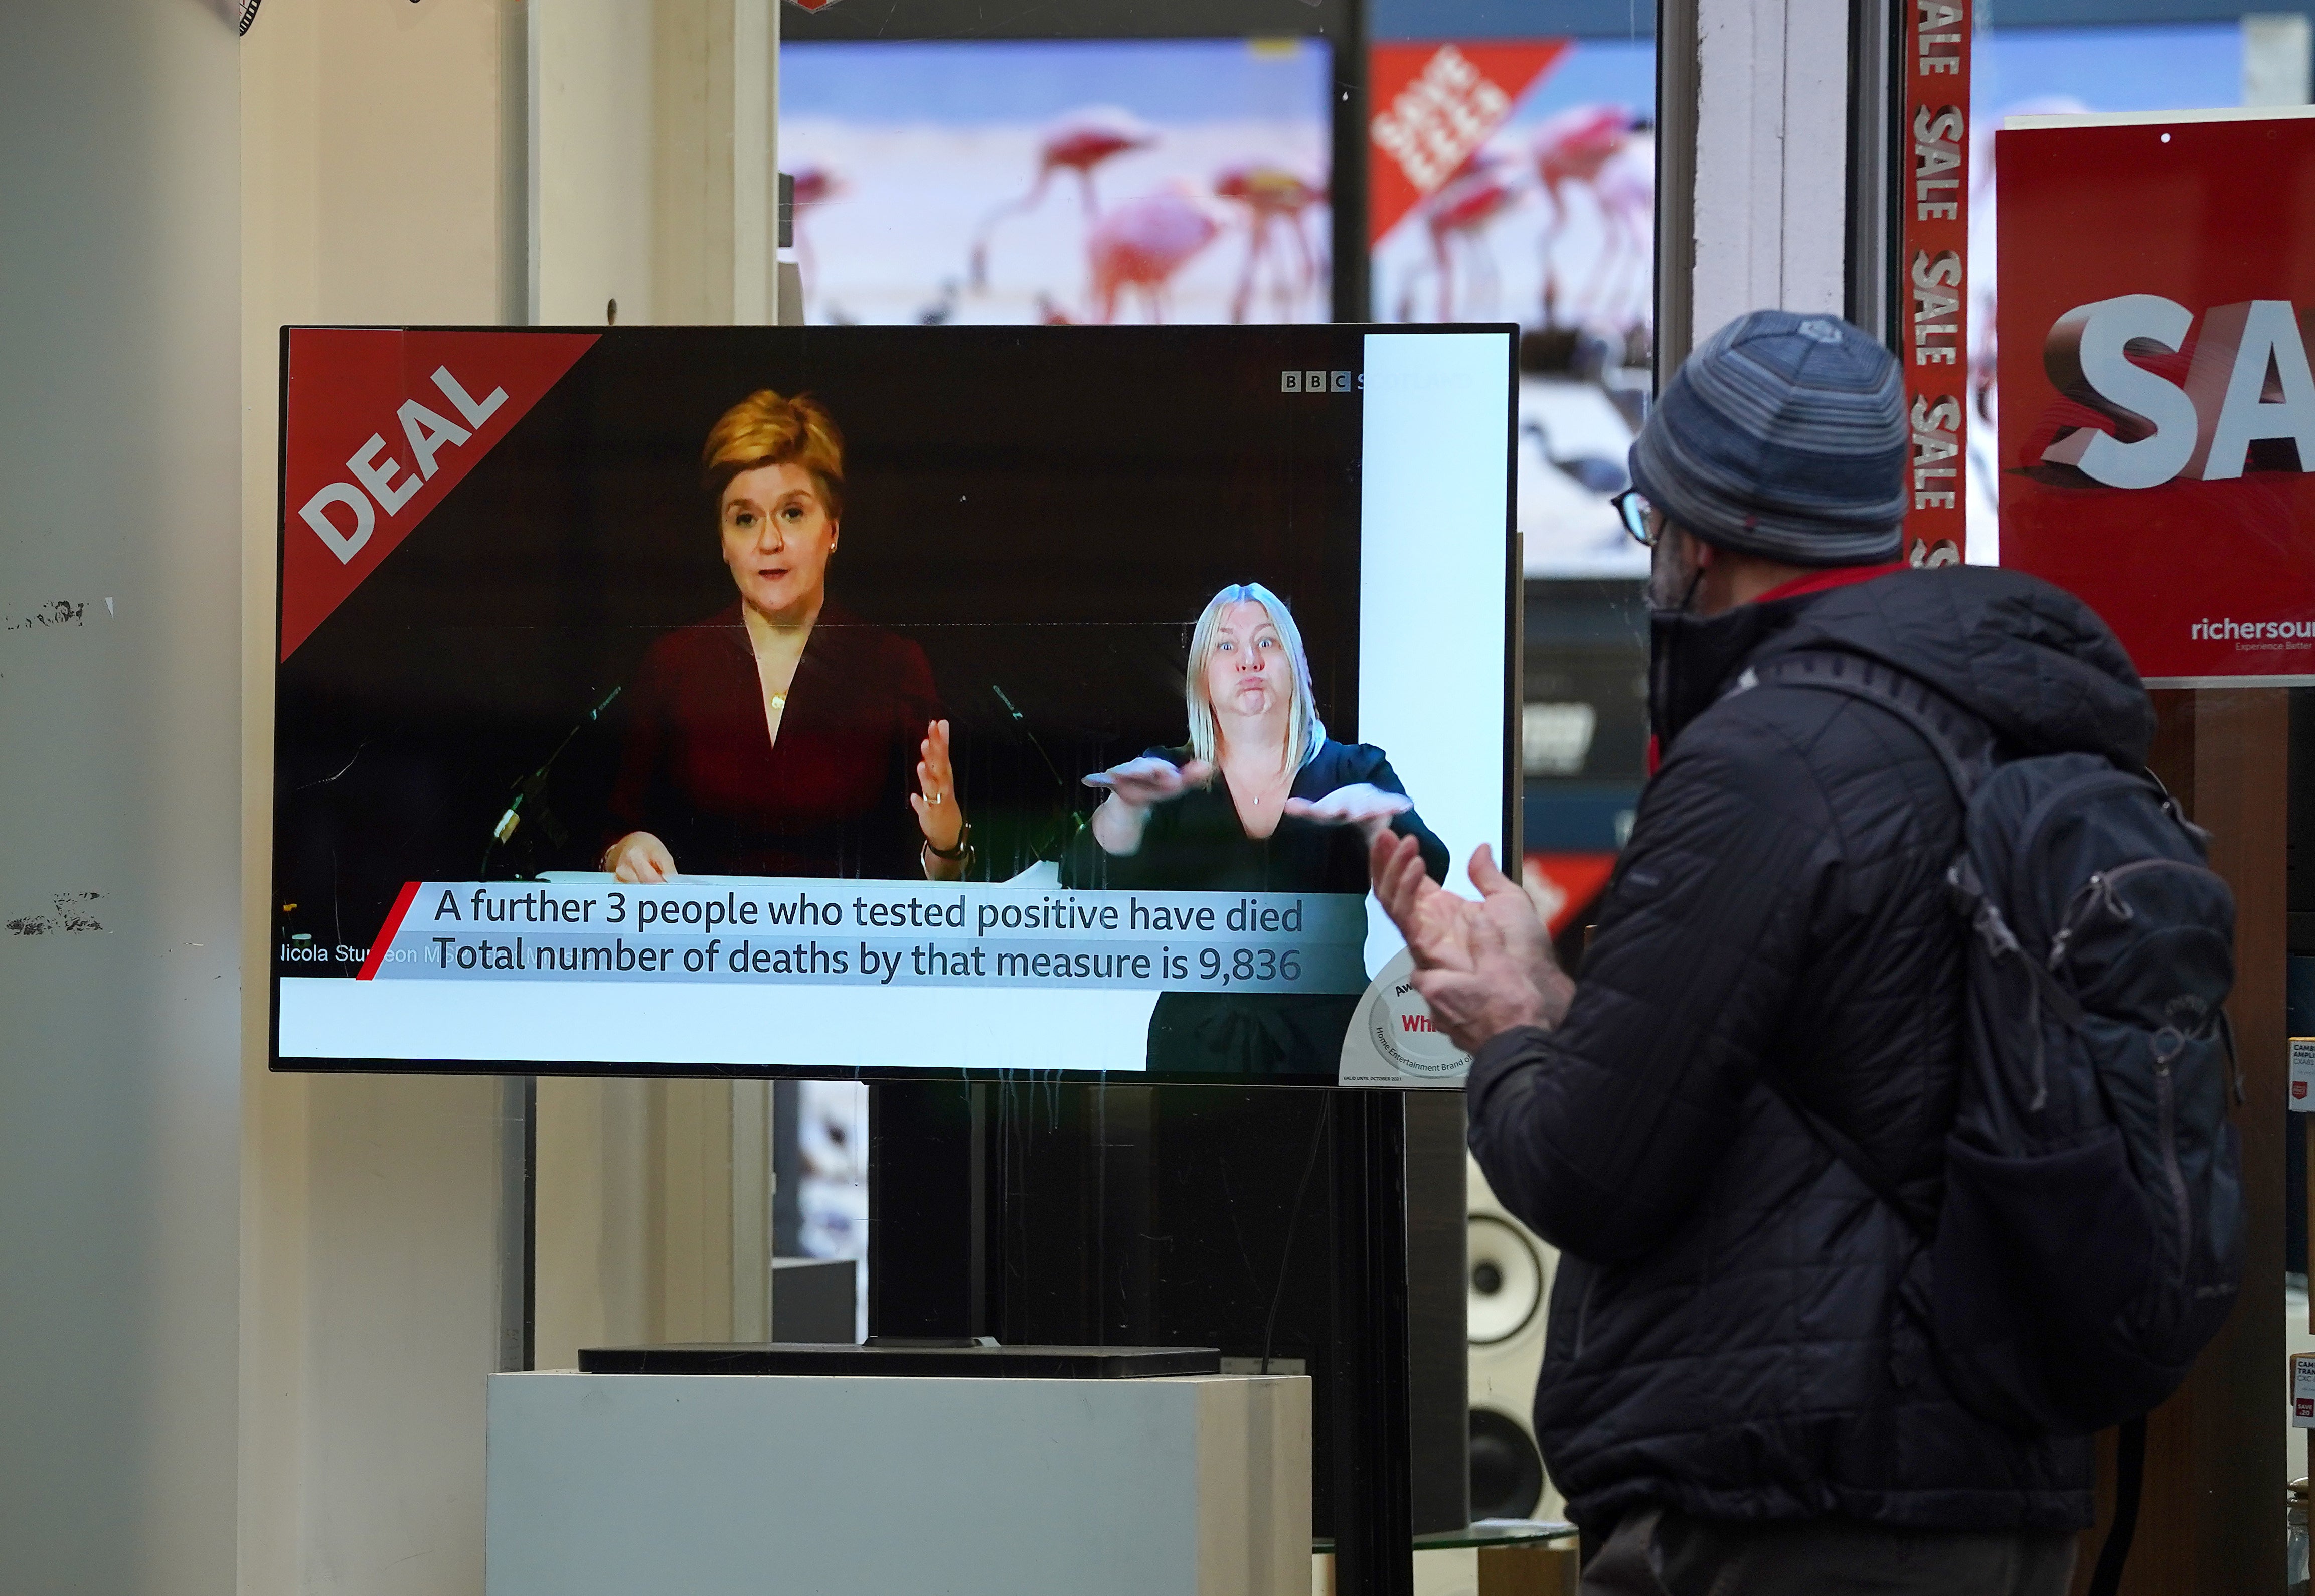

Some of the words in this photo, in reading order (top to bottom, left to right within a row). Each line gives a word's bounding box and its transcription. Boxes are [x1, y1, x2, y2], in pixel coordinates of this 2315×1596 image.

[1913, 104, 1964, 221] SALE
[1911, 249, 1962, 365] SALE
[1283, 373, 1349, 390] BBC
[2041, 294, 2315, 490] SA
[298, 365, 510, 565] DEAL
[1910, 394, 1962, 510] SALE
[2191, 618, 2315, 640] richersou
[434, 889, 462, 921] A
[471, 888, 597, 923] further
[606, 892, 626, 923] 3
[638, 892, 758, 933] people
[768, 893, 842, 926] who
[852, 894, 966, 927] tested
[978, 896, 1118, 937] positive
[1131, 897, 1215, 931] have
[1226, 898, 1303, 932] died
[432, 937, 525, 970] Total
[536, 938, 674, 972] number
[683, 939, 721, 973] of
[729, 940, 849, 975] deaths
[860, 941, 902, 985] by
[911, 942, 986, 977] that
[996, 951, 1151, 979] measure
[1163, 946, 1189, 981] is
[1199, 948, 1302, 986] 9,836
[1376, 1027, 1390, 1050] Home
[1389, 1048, 1440, 1071] Entertainment
[1441, 1059, 1464, 1071] Brand
